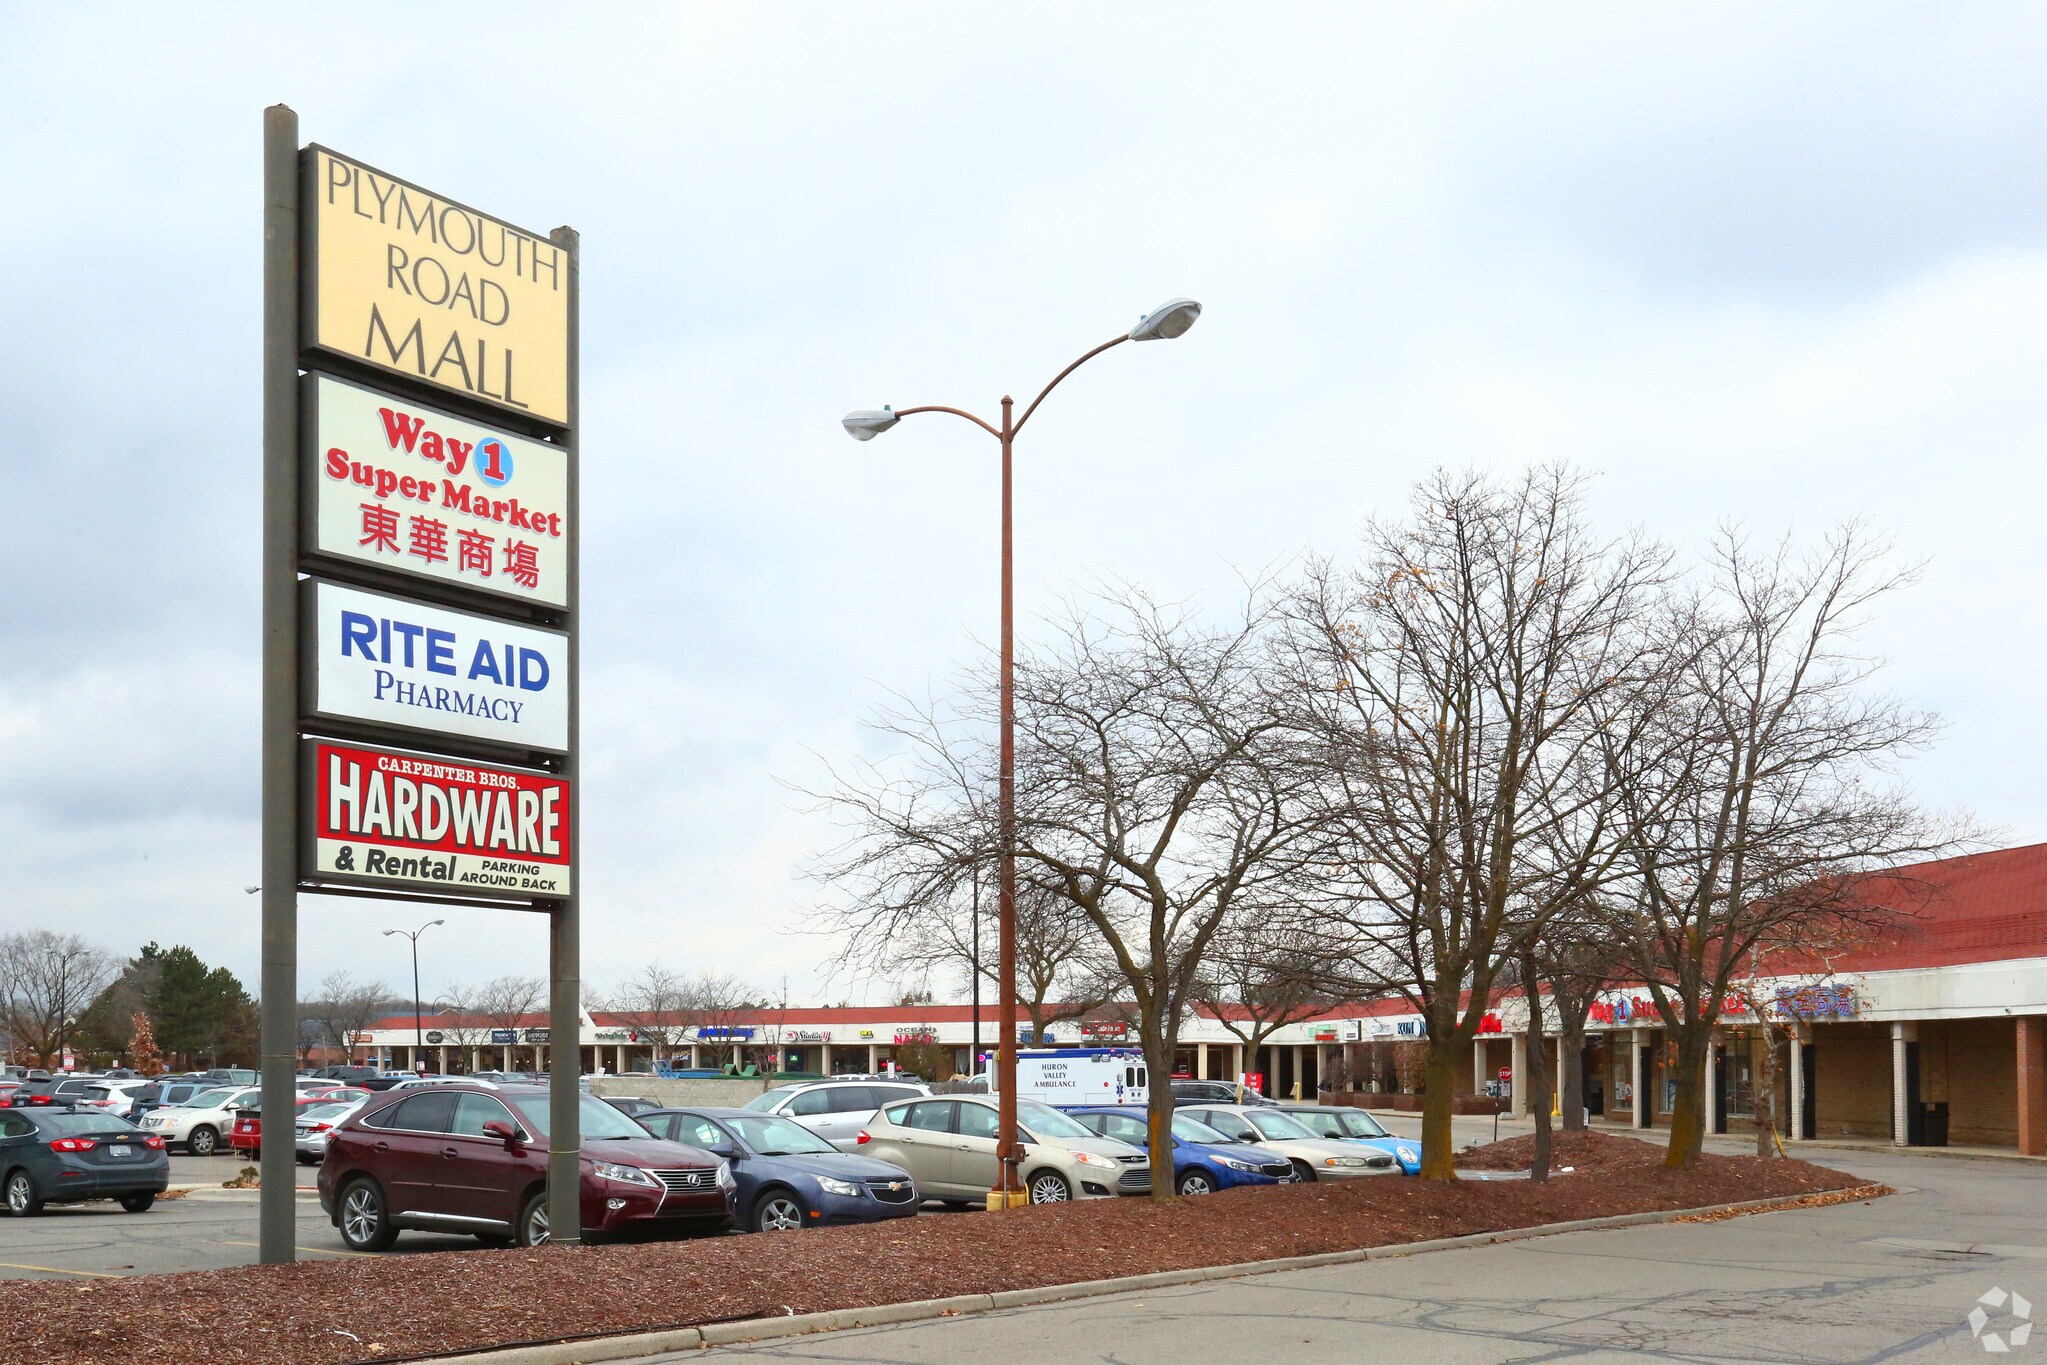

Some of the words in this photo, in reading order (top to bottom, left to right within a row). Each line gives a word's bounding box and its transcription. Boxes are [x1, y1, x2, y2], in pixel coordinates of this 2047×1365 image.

[328, 156, 558, 291] PLYMOUTH
[386, 242, 510, 327] ROAD
[364, 301, 529, 409] MALL
[378, 407, 474, 476] Way
[483, 442, 505, 481] 1
[326, 447, 437, 504] Super
[441, 479, 562, 538] Market
[341, 610, 457, 677] RITE
[467, 638, 551, 692] AID
[373, 669, 524, 724] PHARMACY
[328, 753, 561, 857] HARDWARE
[377, 756, 477, 784] CARPENTER
[479, 771, 521, 790] BROS.
[334, 845, 355, 871] &
[365, 848, 457, 881] Rental
[459, 871, 518, 888] AROUND
[521, 877, 557, 891] BACK
[481, 860, 541, 876] PARKING
[1397, 1018, 1427, 1037] KUMON
[1034, 1080, 1077, 1088] AMBULANCE
